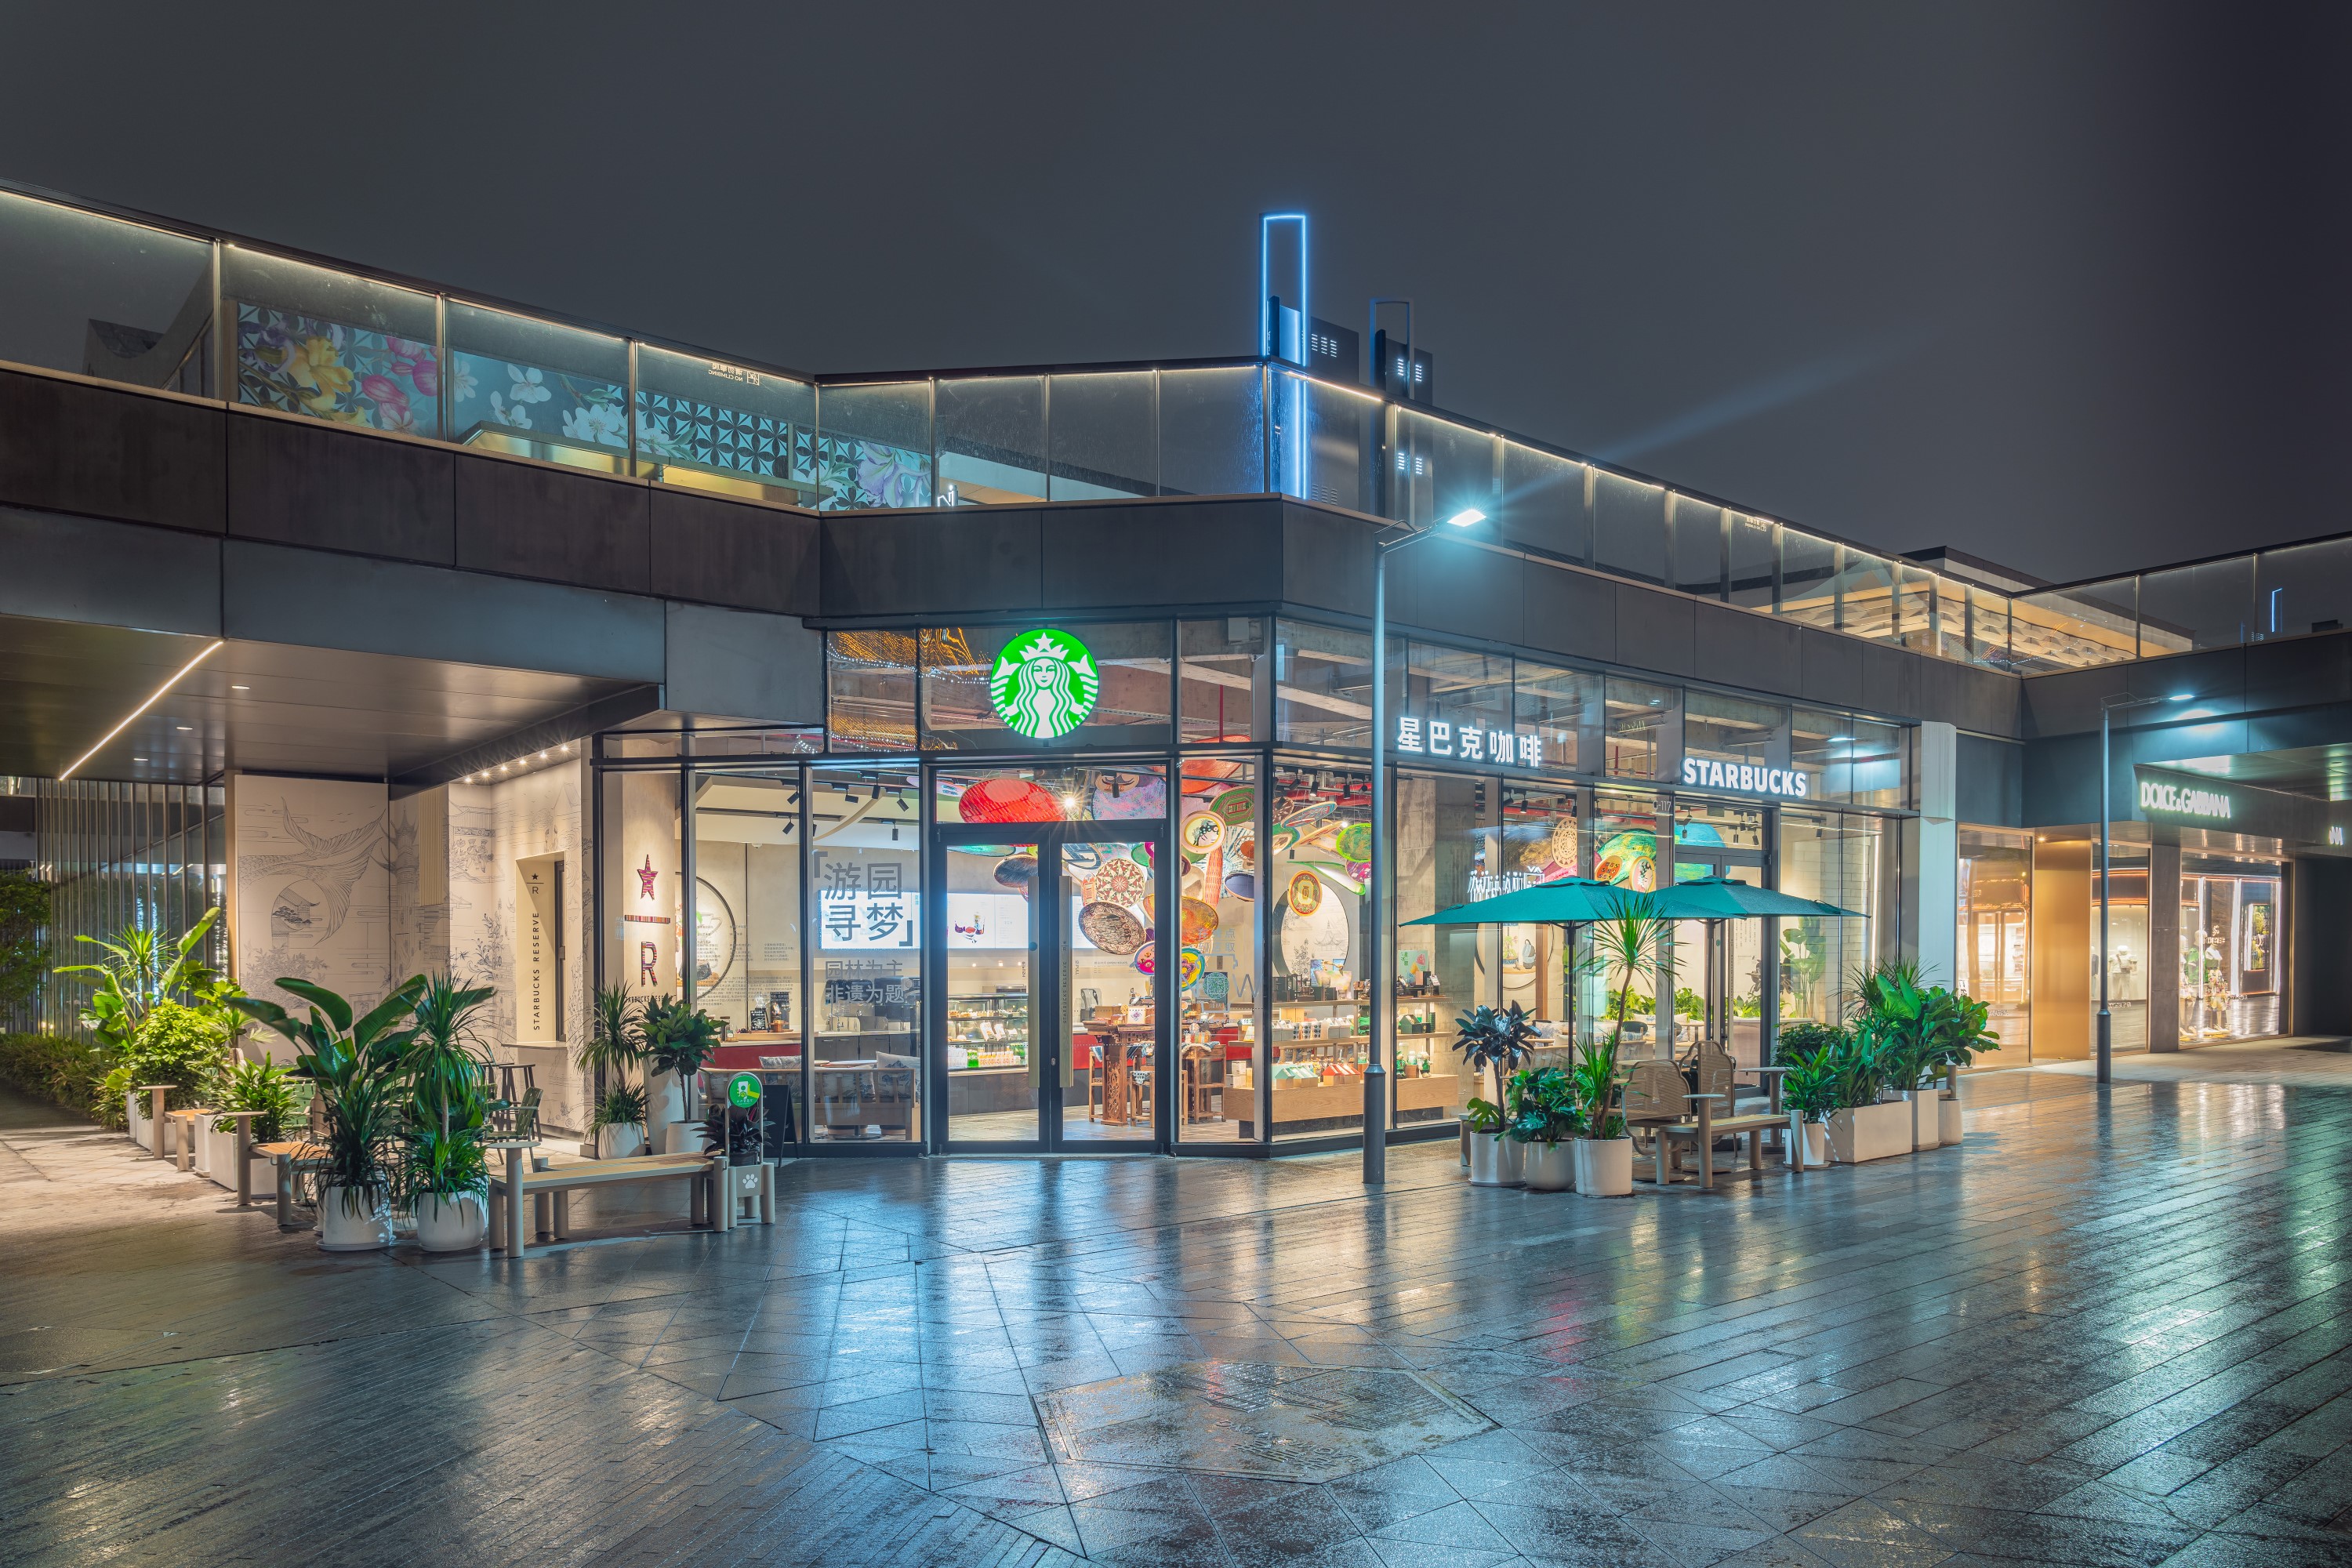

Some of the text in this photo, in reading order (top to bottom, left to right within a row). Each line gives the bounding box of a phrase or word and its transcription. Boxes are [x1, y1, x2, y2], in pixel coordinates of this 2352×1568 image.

[1397, 717, 1542, 767] 星巴克咖啡
[1683, 757, 1806, 797] STARBUCKS
[641, 941, 659, 988] R
[825, 959, 904, 979] 园林为主
[826, 982, 906, 1004] 非遗为题
